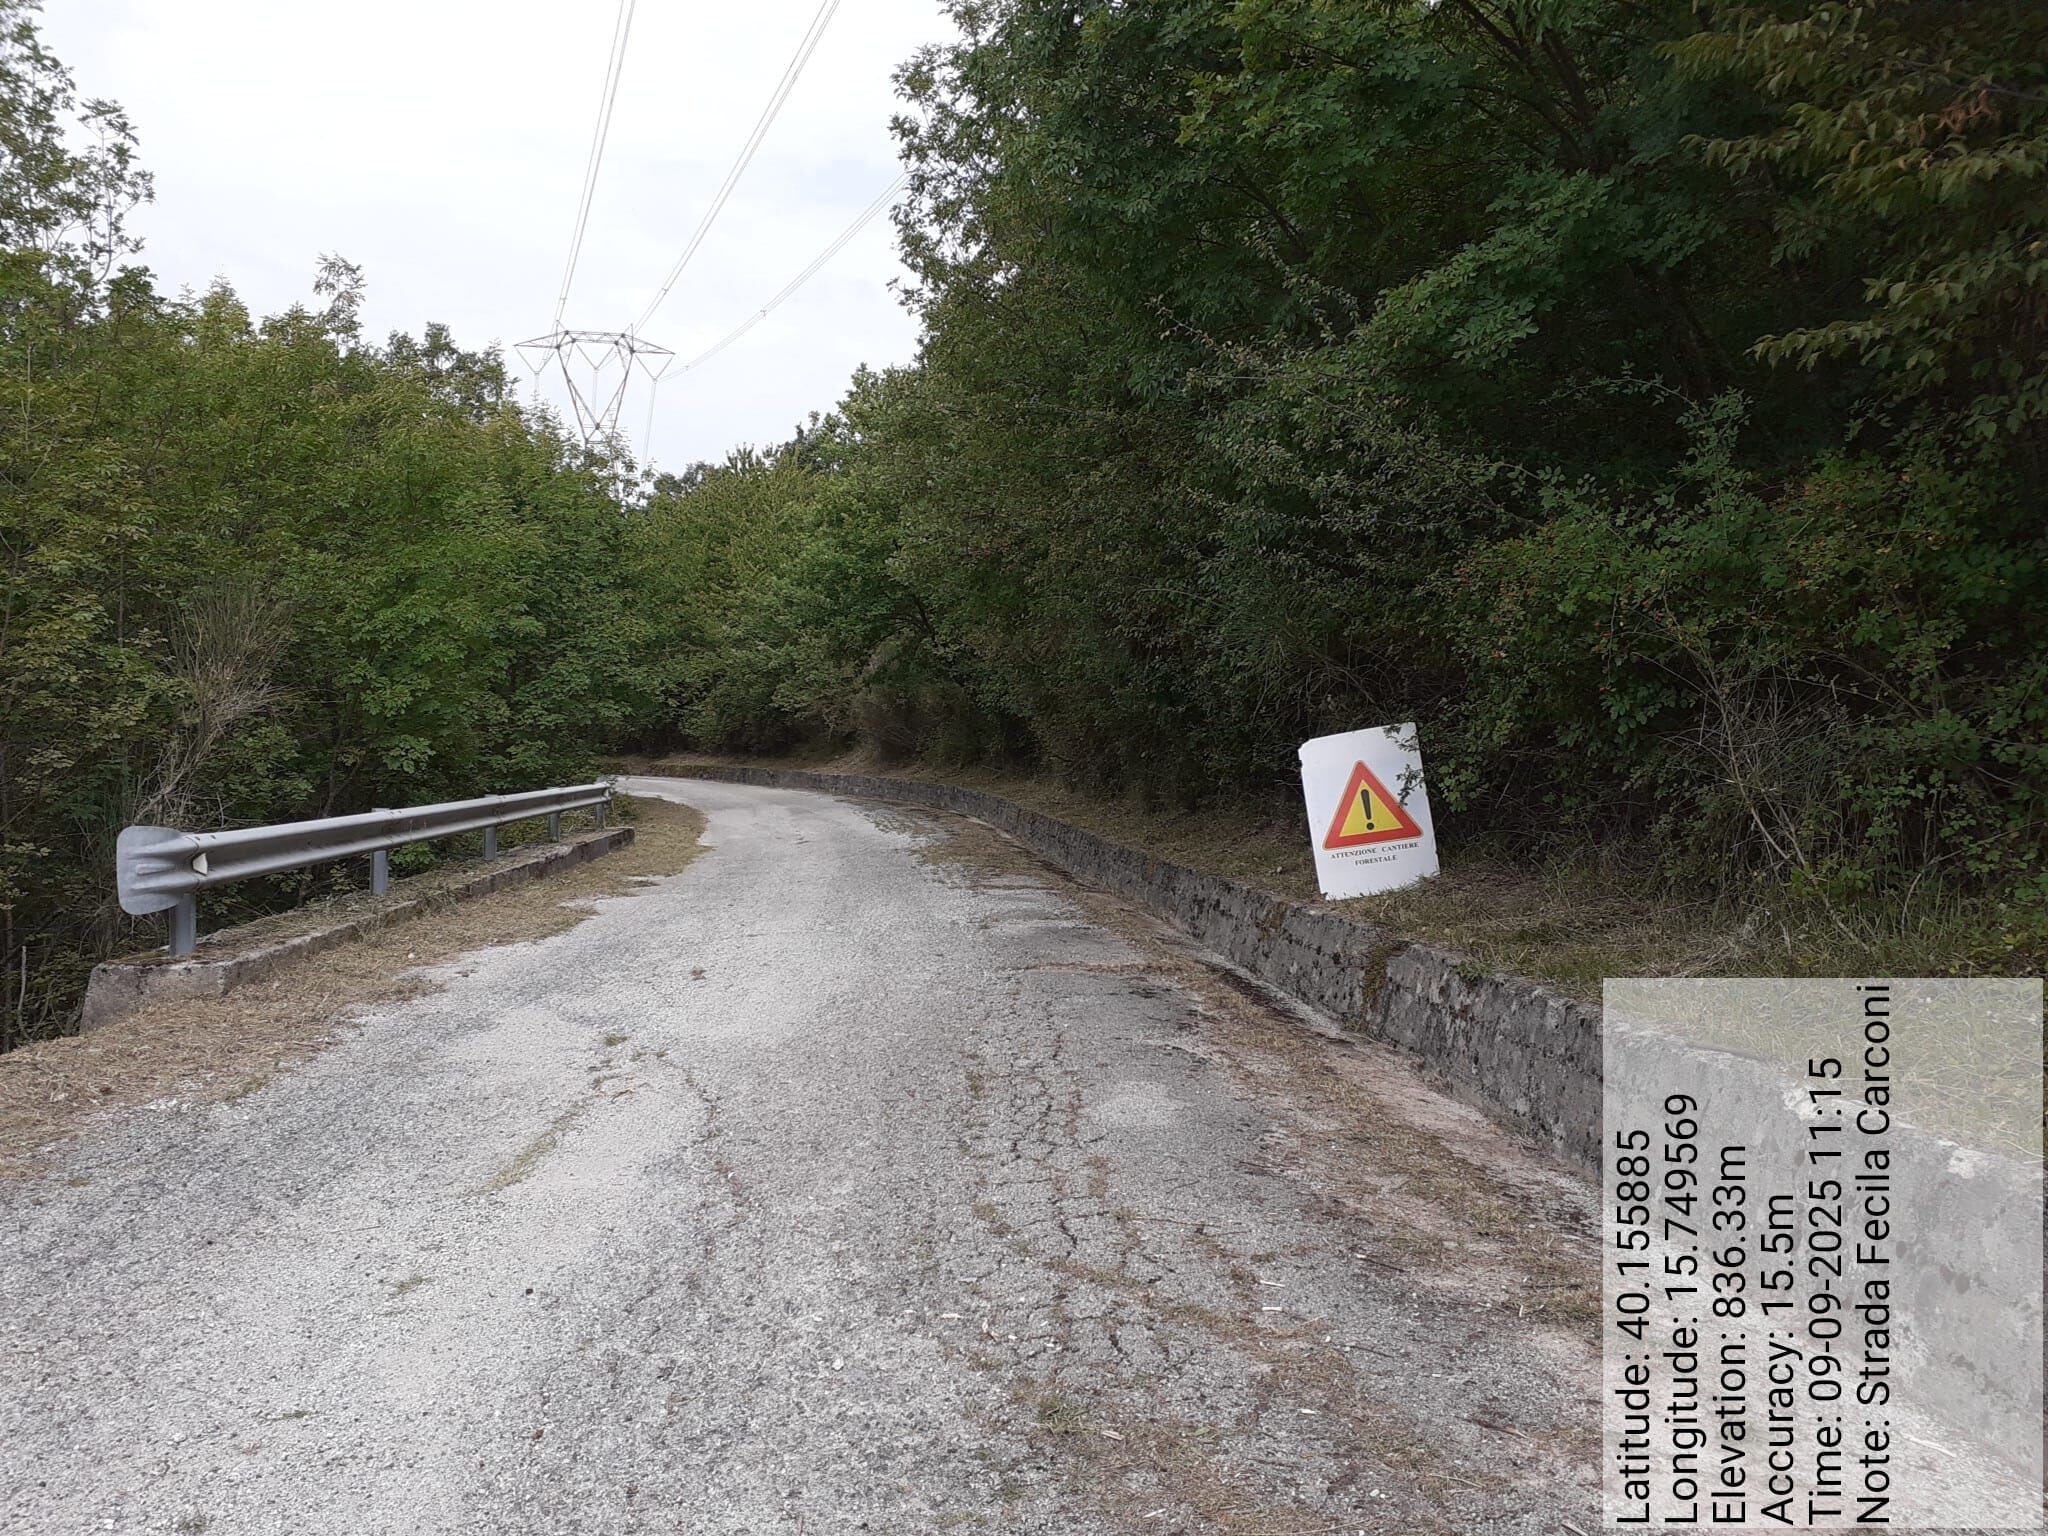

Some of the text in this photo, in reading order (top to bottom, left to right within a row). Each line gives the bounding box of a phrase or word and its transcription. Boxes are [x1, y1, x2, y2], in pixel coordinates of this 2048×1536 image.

[1331, 842, 1419, 859] ATTENZIONE CANTIERE
[1355, 855, 1397, 866] FORESTALE
